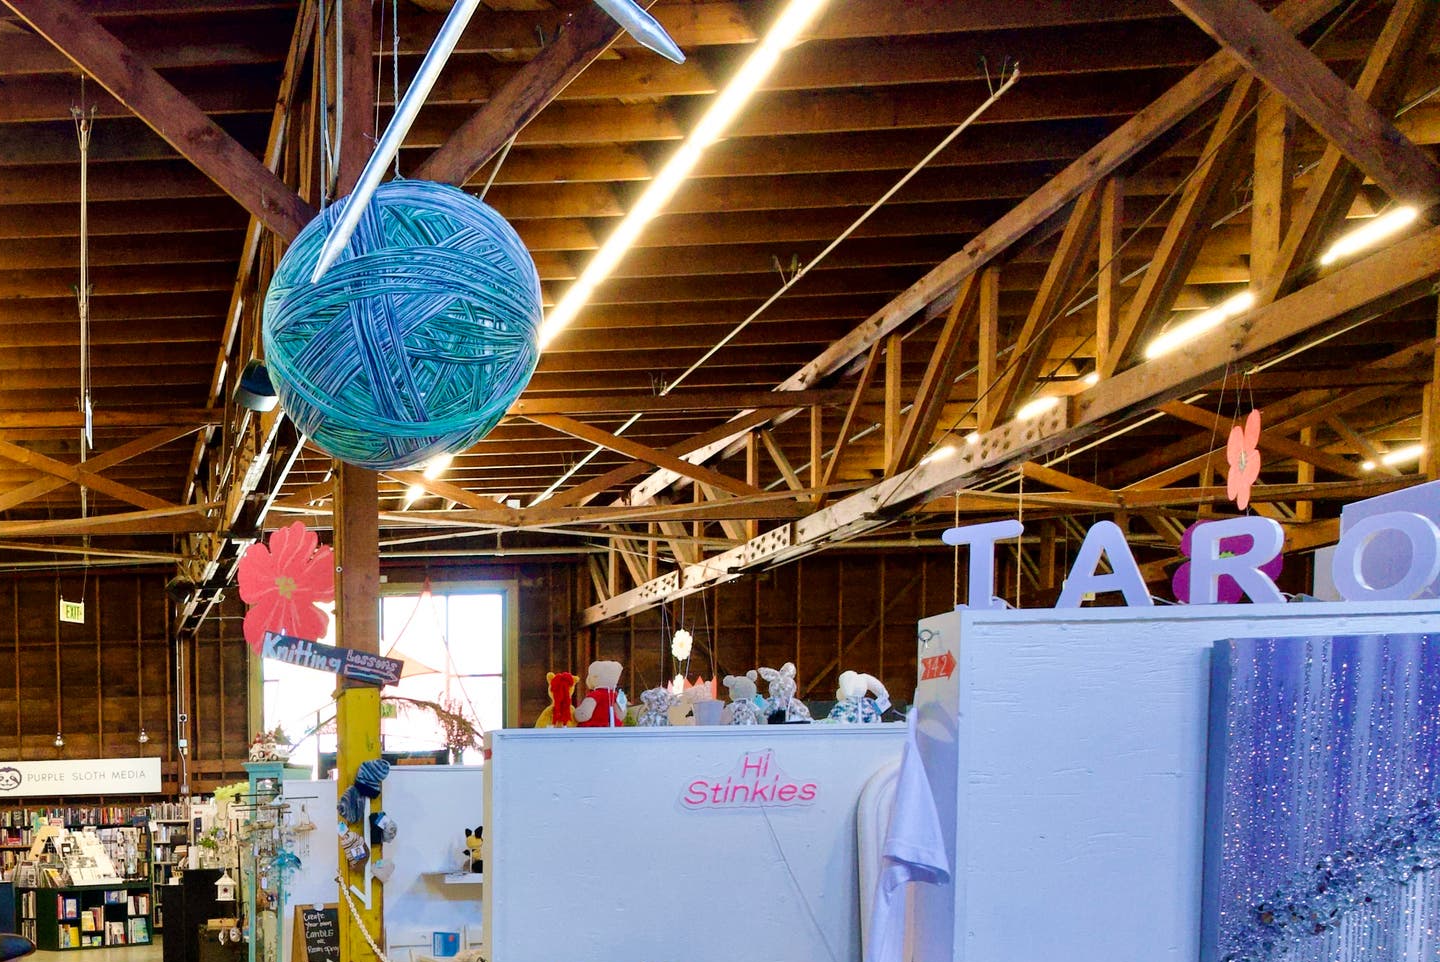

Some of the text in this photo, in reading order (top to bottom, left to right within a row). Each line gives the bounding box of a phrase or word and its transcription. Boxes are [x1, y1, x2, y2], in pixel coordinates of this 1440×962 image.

[66, 605, 80, 619] EXIT
[262, 632, 398, 673] Knitting Lessons
[27, 770, 146, 782] PURPLE SLOTH MEDIA
[684, 773, 818, 804] Stinkies
[303, 912, 325, 922] Create
